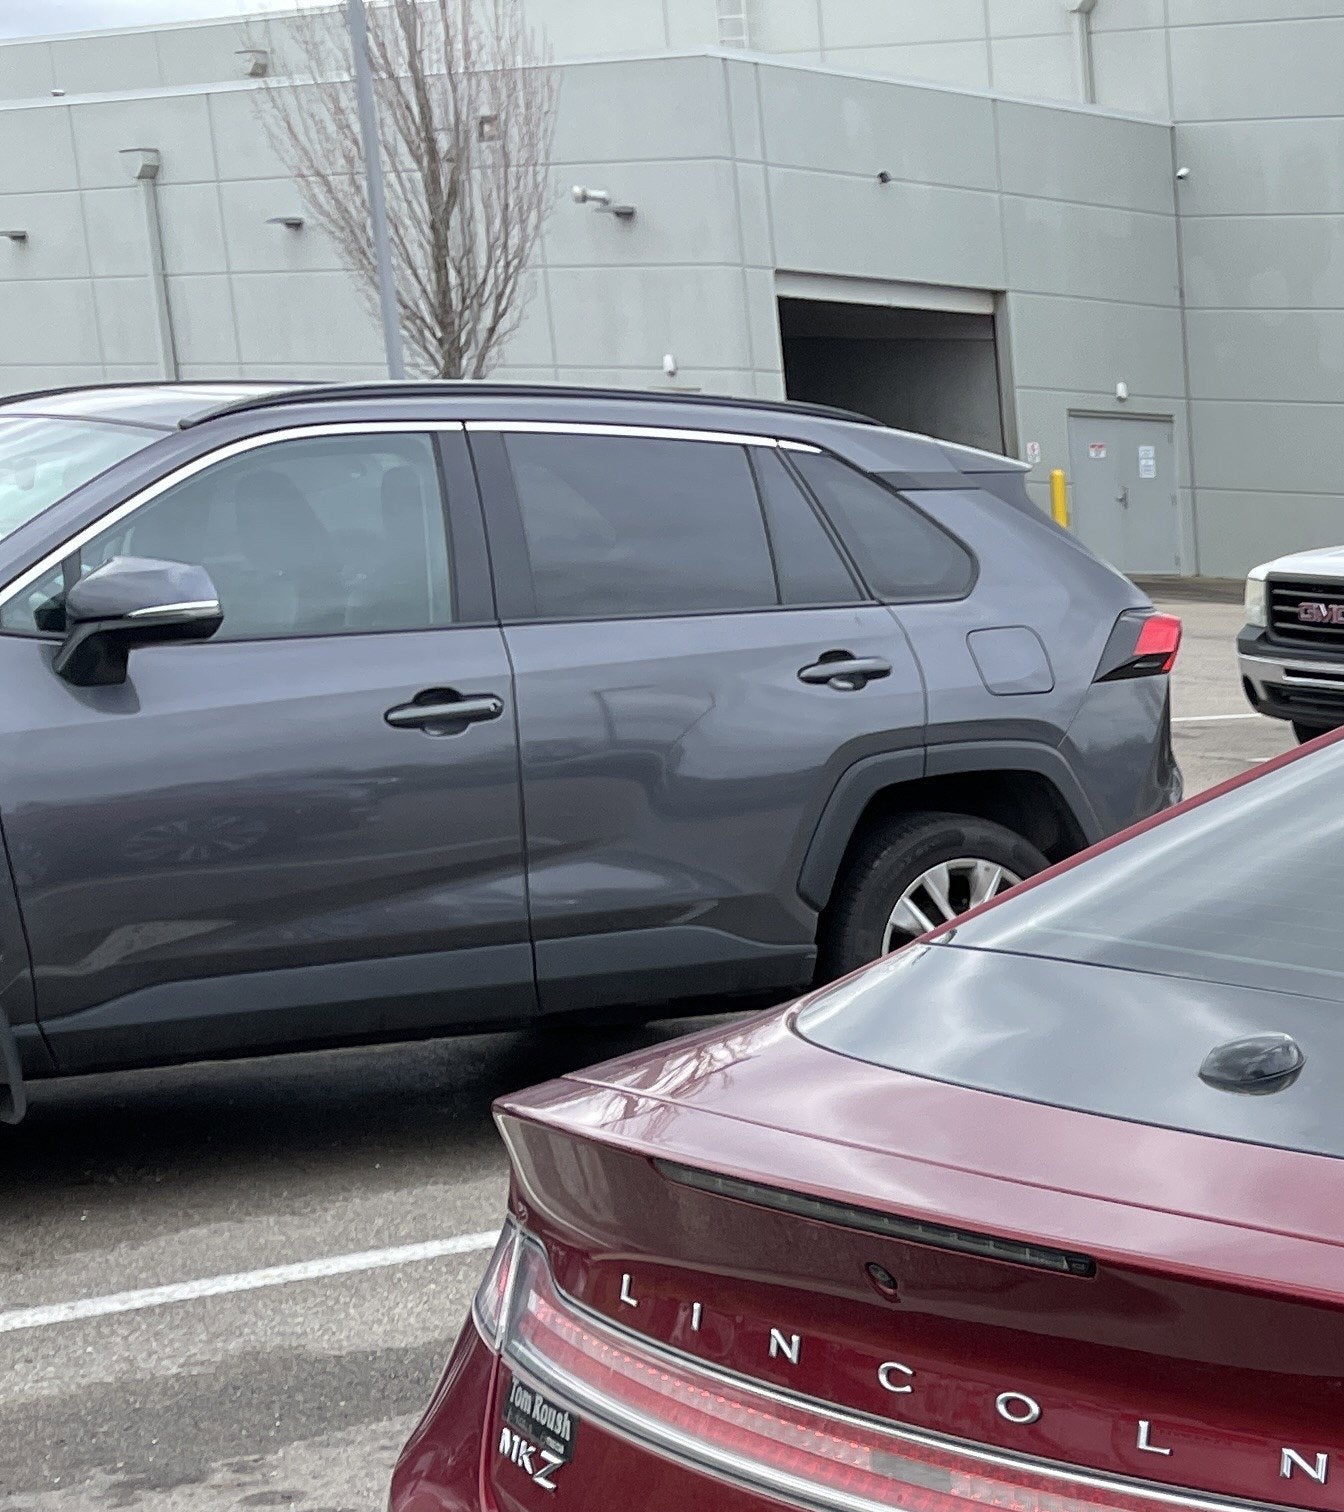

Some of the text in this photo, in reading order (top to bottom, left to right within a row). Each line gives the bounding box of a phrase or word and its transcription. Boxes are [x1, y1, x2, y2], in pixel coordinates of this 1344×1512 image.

[509, 1377, 532, 1415] Tom
[532, 1393, 571, 1442] Roush
[619, 1273, 1330, 1484] LINCOLN
[498, 1426, 566, 1491] MKZ
